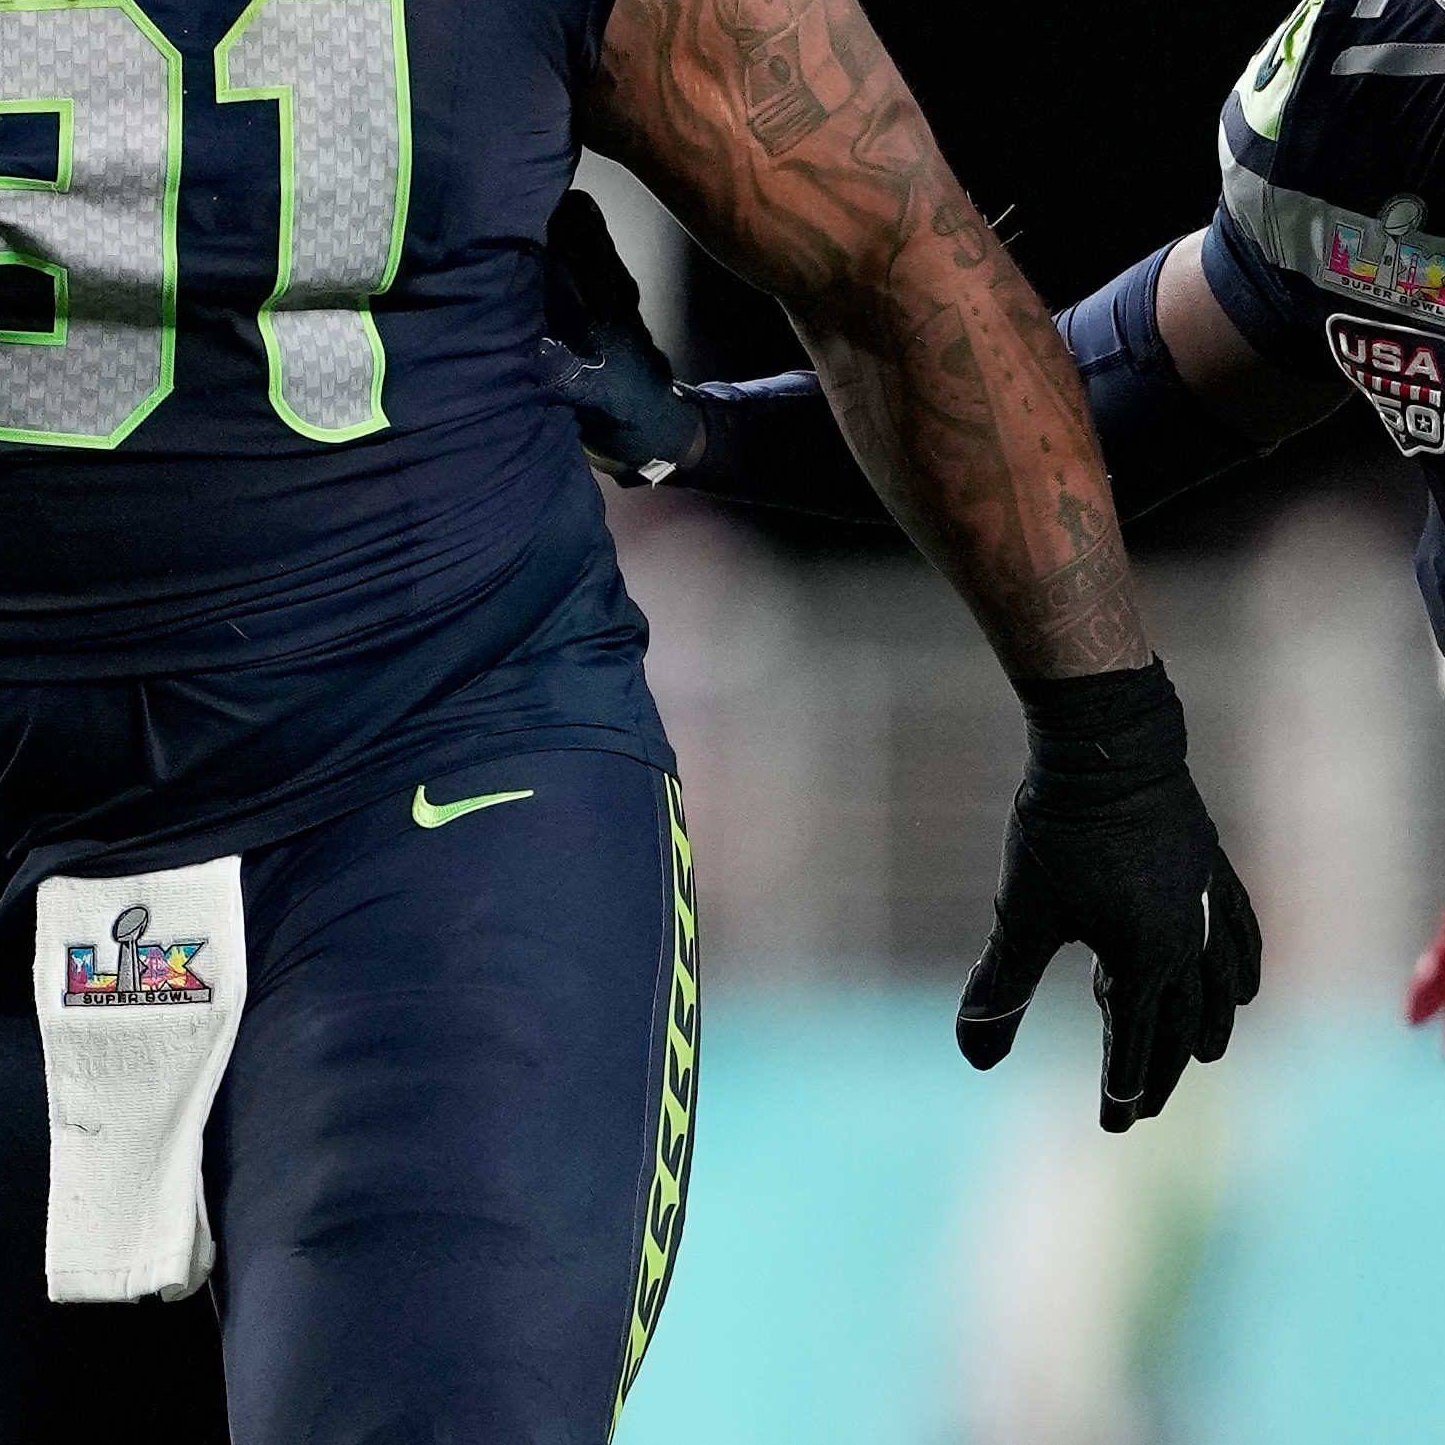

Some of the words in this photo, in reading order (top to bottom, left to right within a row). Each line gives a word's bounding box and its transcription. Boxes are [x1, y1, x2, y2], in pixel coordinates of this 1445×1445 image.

[1340, 276, 1392, 300] SUPER
[1399, 296, 1444, 315] BOWL
[1338, 329, 1442, 384] USA
[1371, 393, 1441, 443] 50
[82, 991, 138, 1005] SUPER
[145, 990, 193, 1003] BOWL
